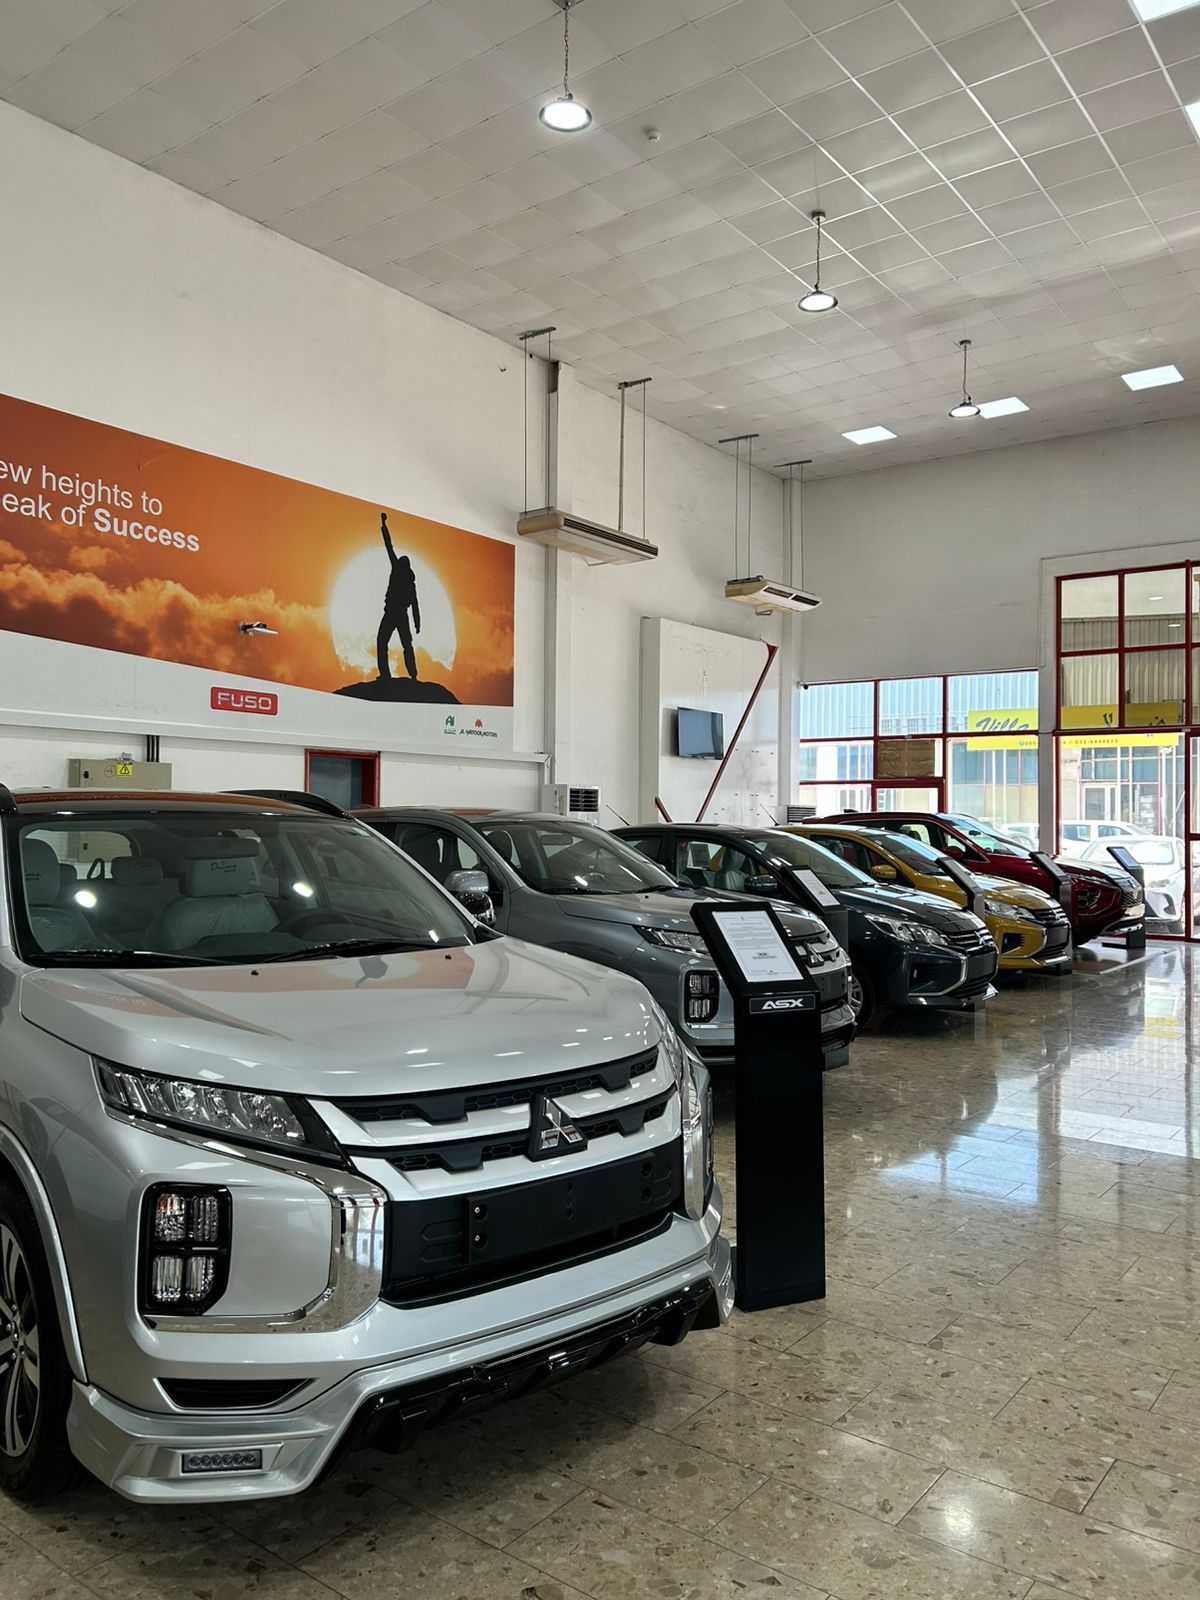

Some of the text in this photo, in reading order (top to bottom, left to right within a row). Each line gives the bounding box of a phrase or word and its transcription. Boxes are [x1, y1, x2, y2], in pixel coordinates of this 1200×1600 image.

[0, 459, 163, 516] ew heights to
[60, 504, 87, 528] of
[93, 507, 200, 552] Success
[217, 692, 272, 711] FUSO
[761, 998, 804, 1010] ASX
